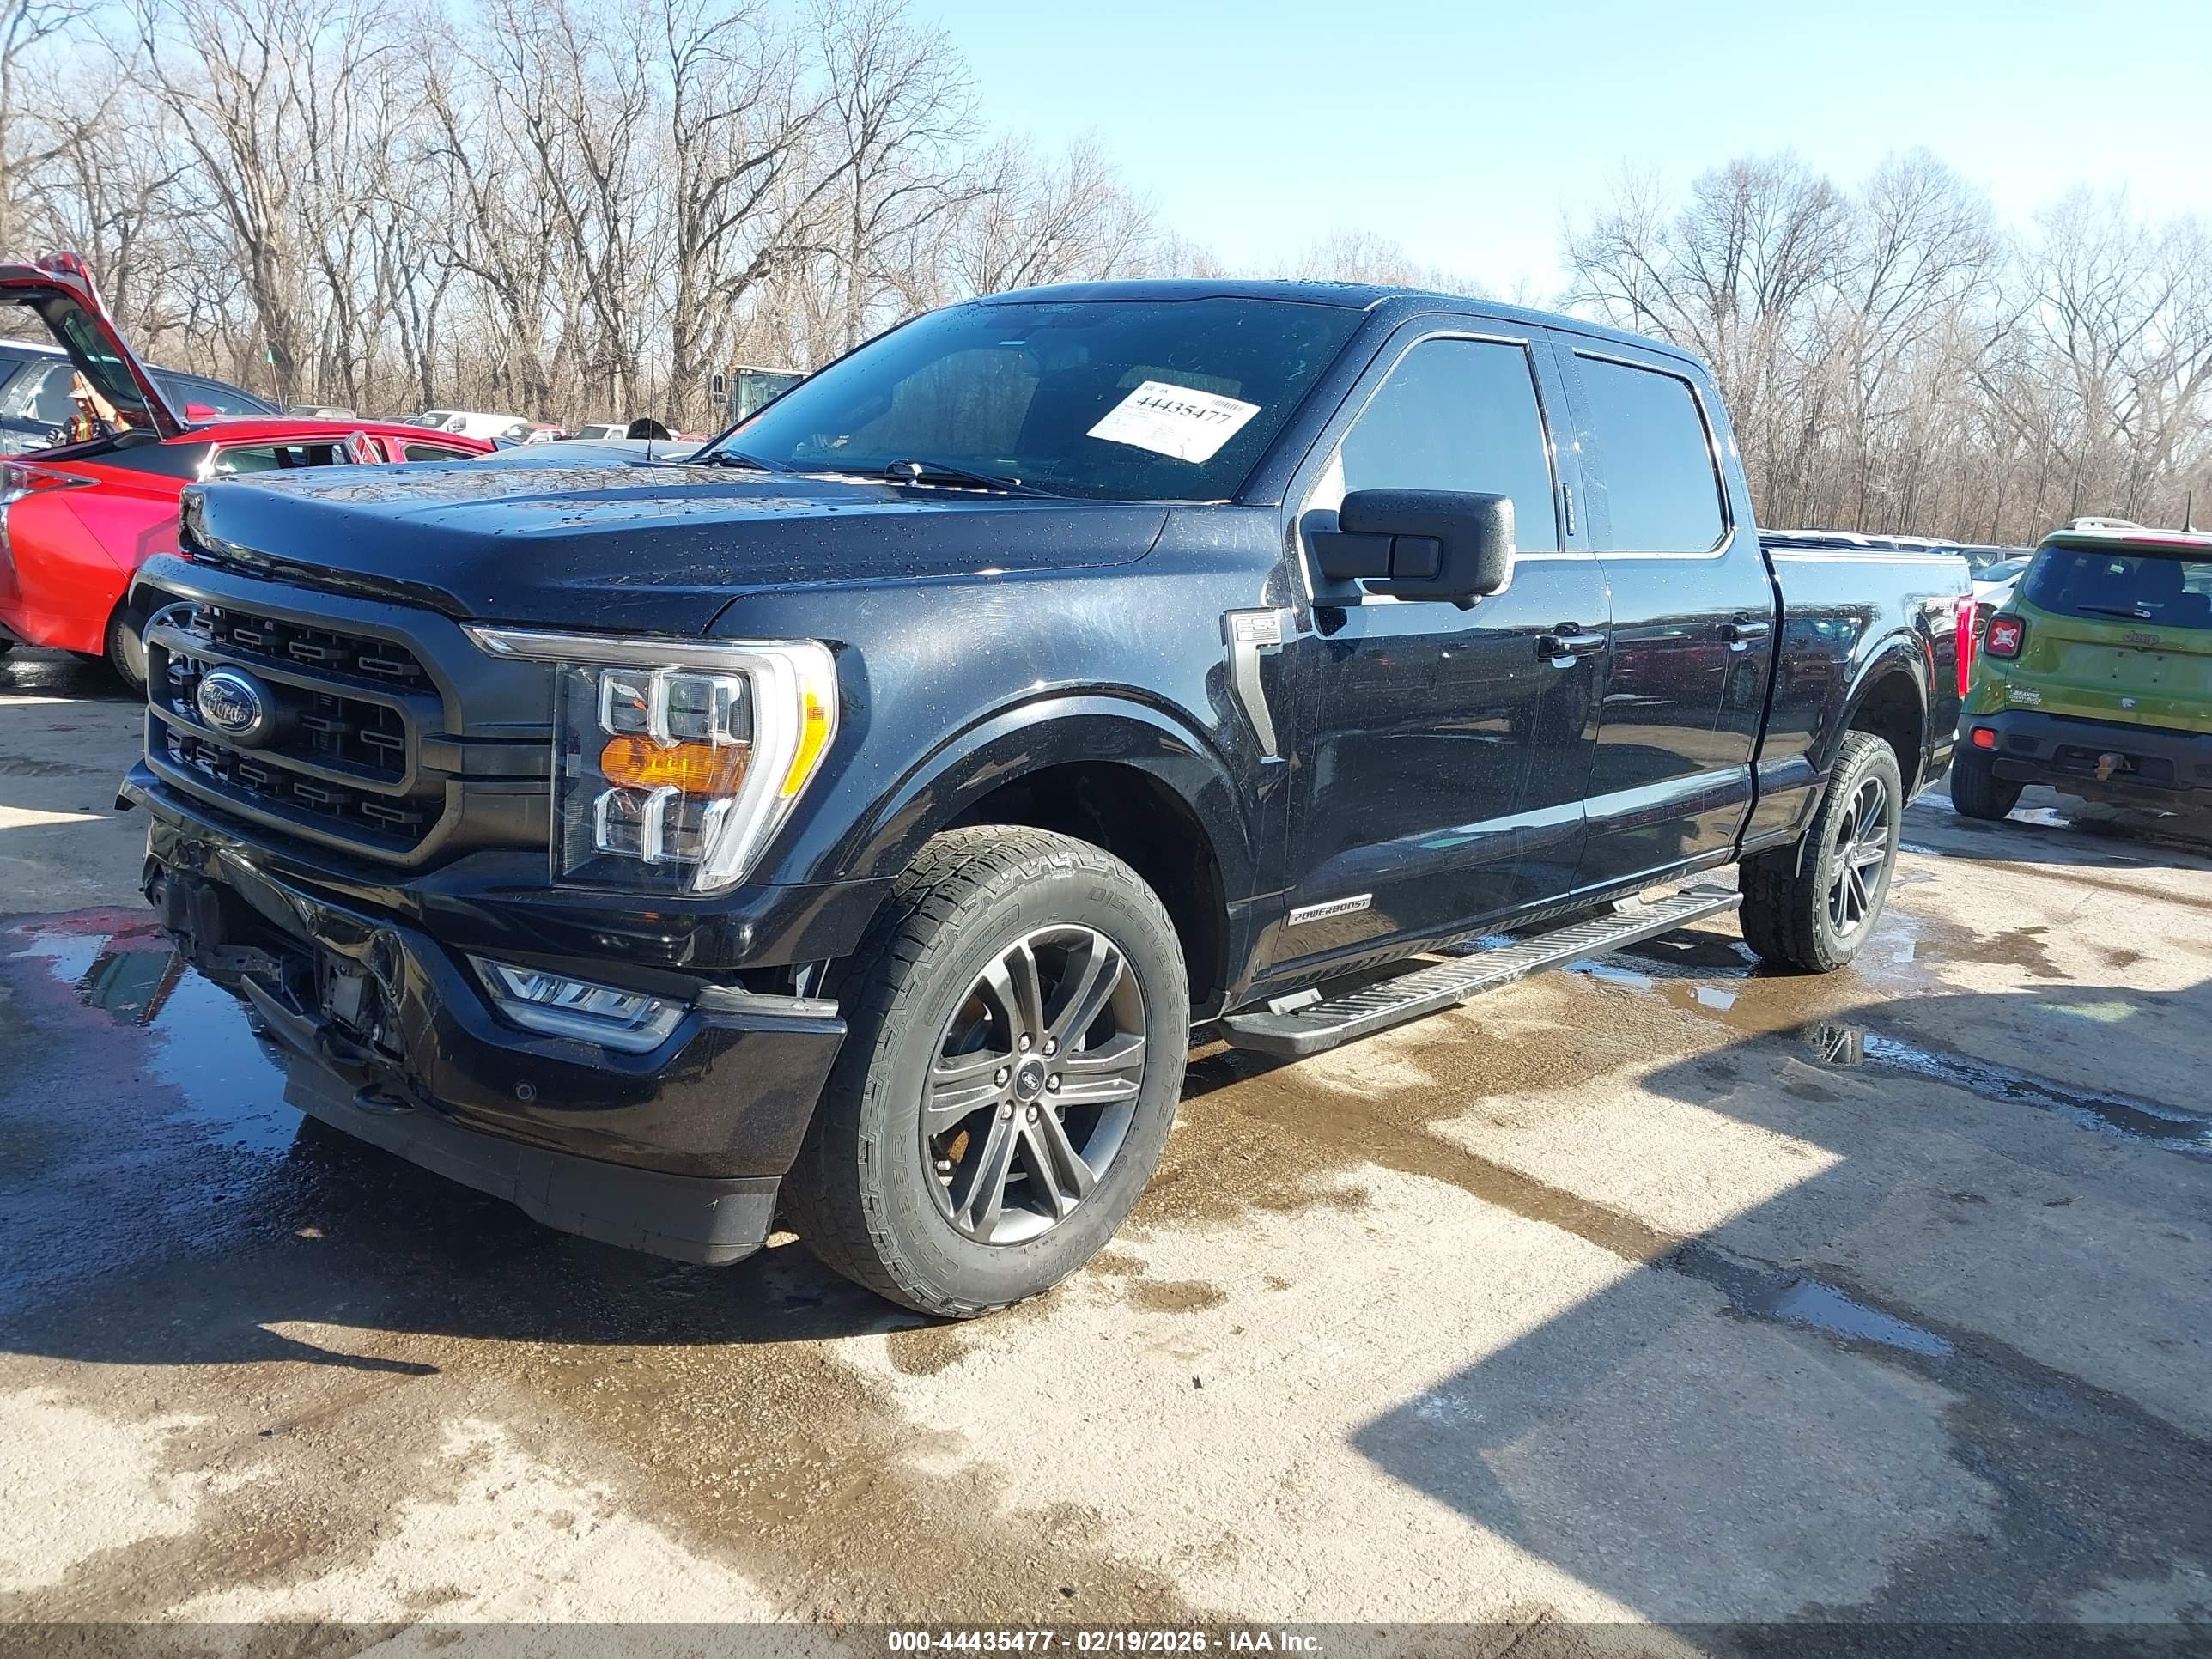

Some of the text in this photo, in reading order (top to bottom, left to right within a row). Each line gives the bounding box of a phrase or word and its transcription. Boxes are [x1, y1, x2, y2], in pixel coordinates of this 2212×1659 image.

[1136, 396, 1233, 426] 44435477
[2123, 630, 2159, 645] Jeep
[1294, 898, 1369, 921] POWERBOOST
[1086, 886, 1181, 1036] DISCOVERER
[892, 1133, 959, 1279] COOPER
